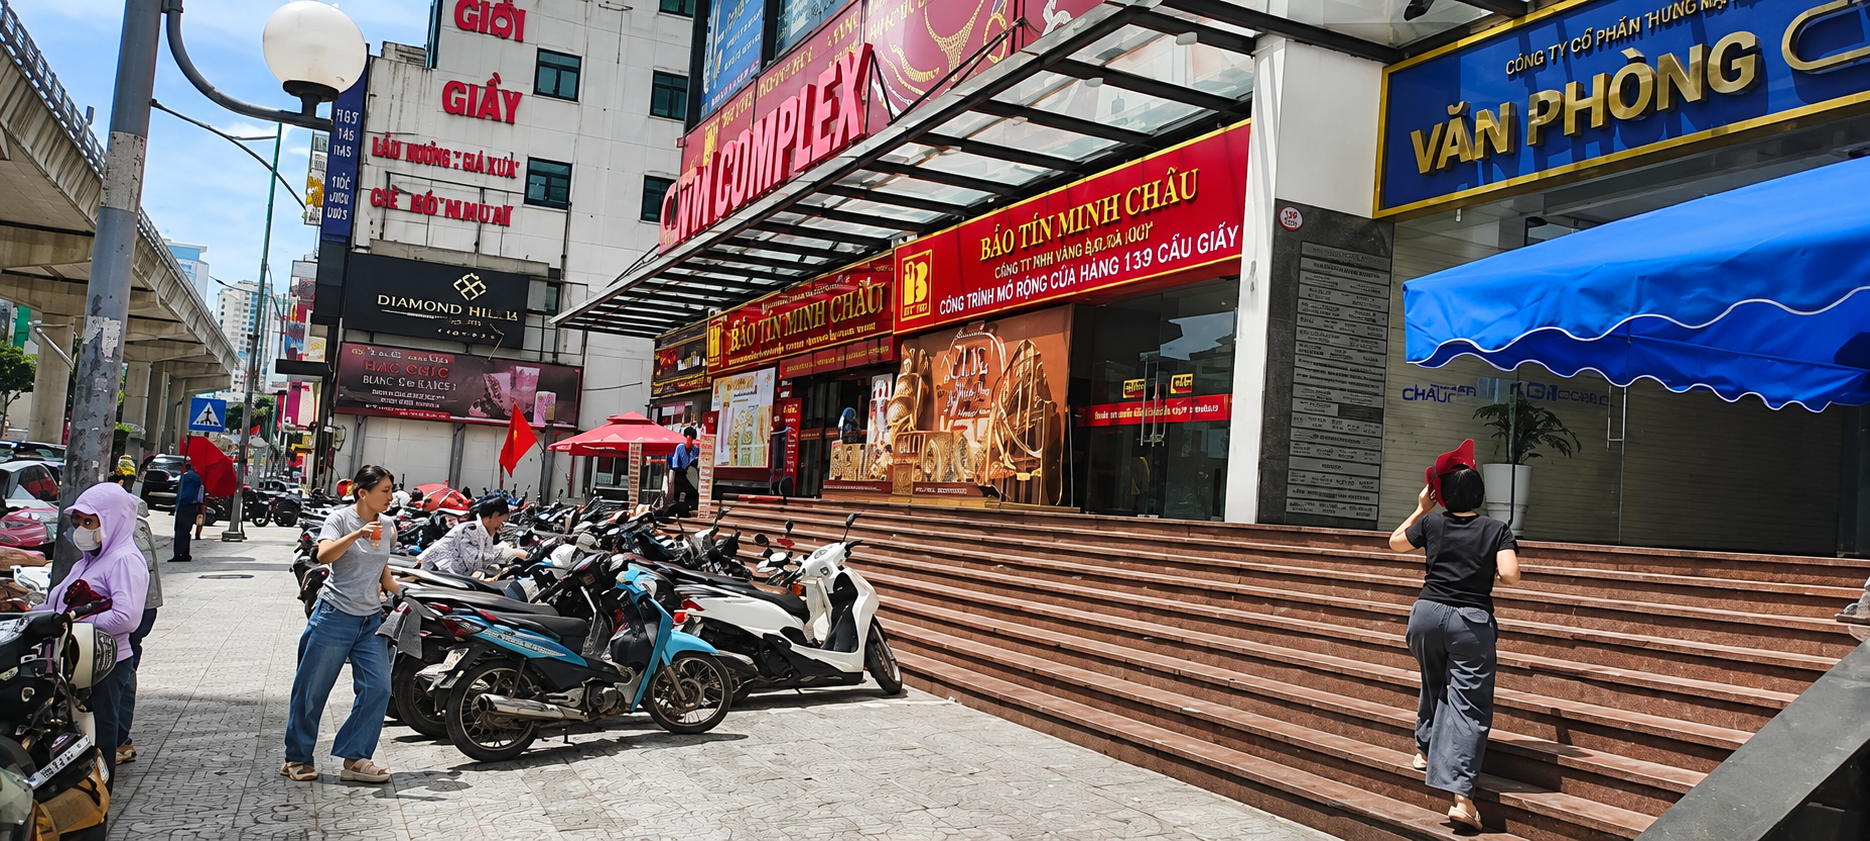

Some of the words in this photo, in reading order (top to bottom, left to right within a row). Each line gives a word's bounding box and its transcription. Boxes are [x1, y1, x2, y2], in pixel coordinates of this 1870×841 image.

[1548, 41, 1569, 60] TY
[1410, 100, 1516, 175] VĂN
[1527, 31, 1762, 146] PHÒNG
[714, 42, 873, 218] COMPLEX
[1018, 212, 1055, 250] TÍN
[1057, 193, 1121, 239] MINH
[1124, 247, 1153, 272] 139
[377, 294, 463, 315] DIAMOND
[784, 299, 828, 338] MINH
